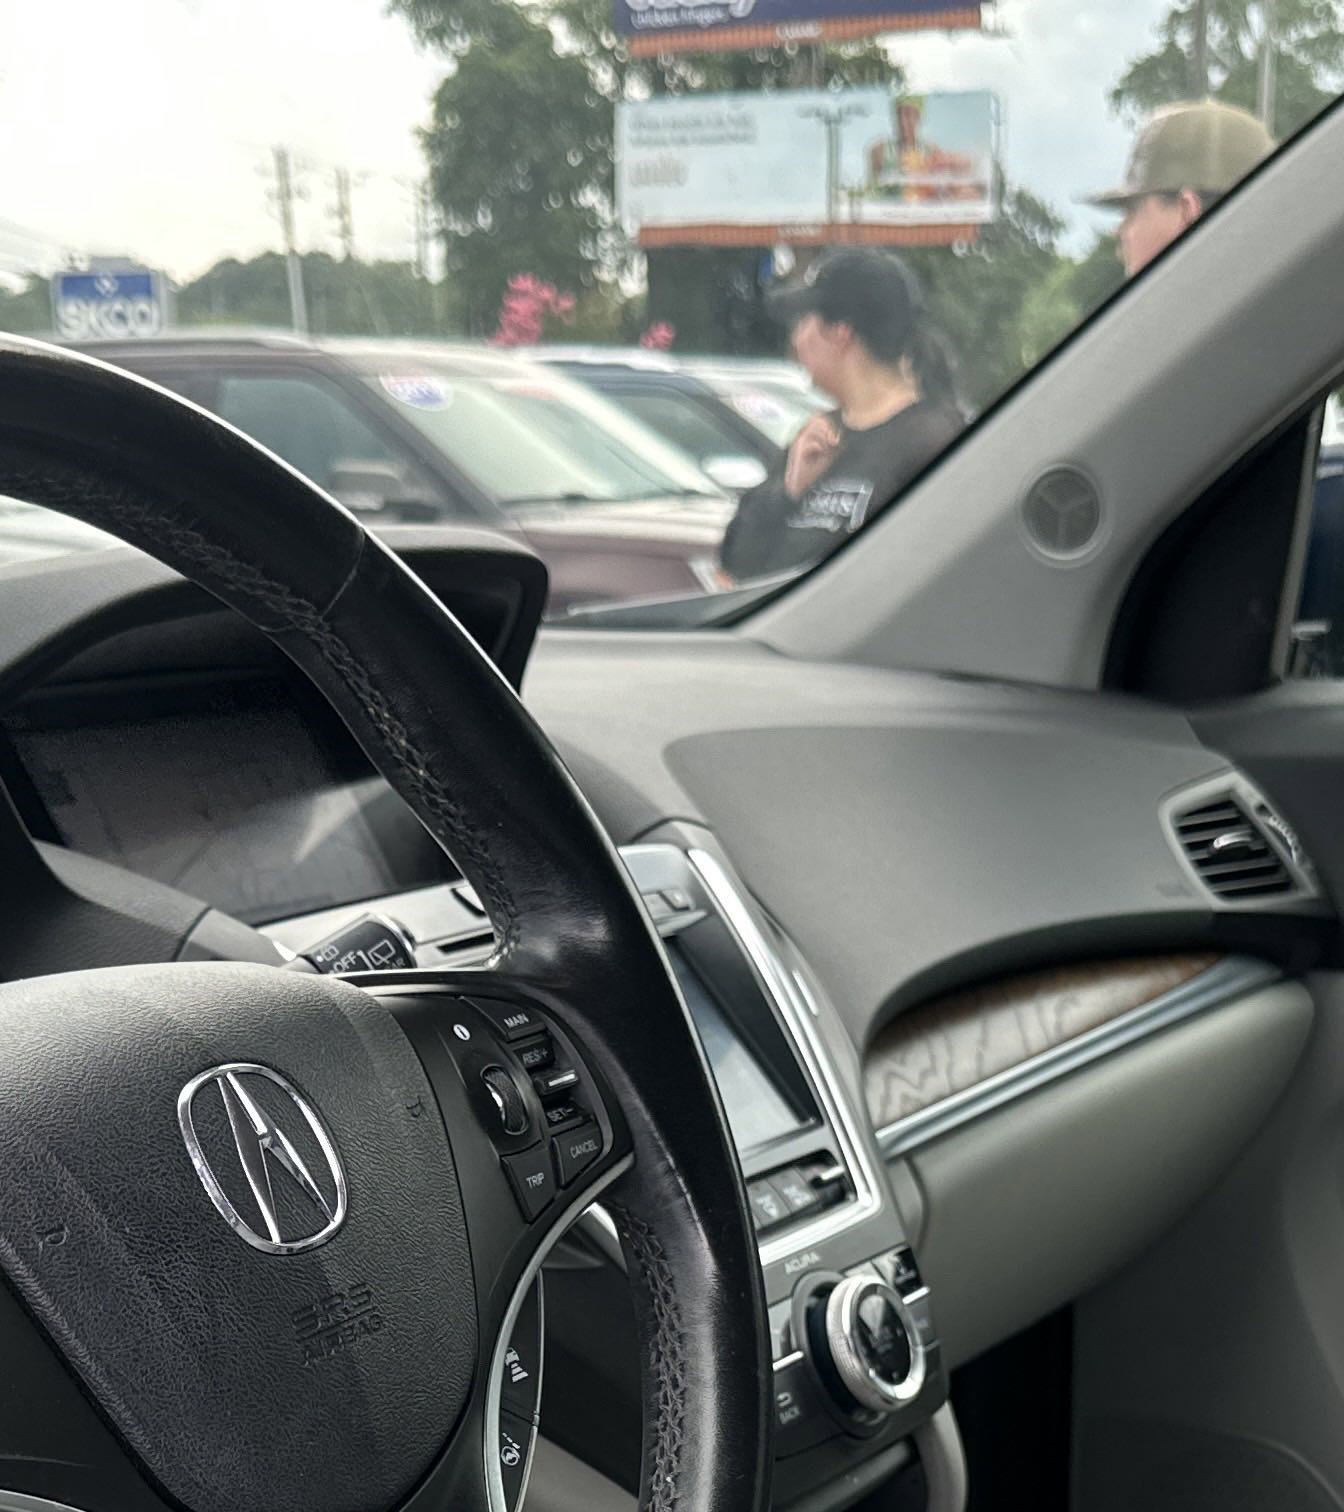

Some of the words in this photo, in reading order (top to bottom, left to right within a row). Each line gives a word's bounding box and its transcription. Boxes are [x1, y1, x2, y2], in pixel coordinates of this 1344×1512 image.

[504, 1013, 529, 1028] MAIN
[570, 1139, 598, 1159] CANCEL
[526, 1172, 545, 1188] TRIP
[784, 1251, 821, 1275] ACURA
